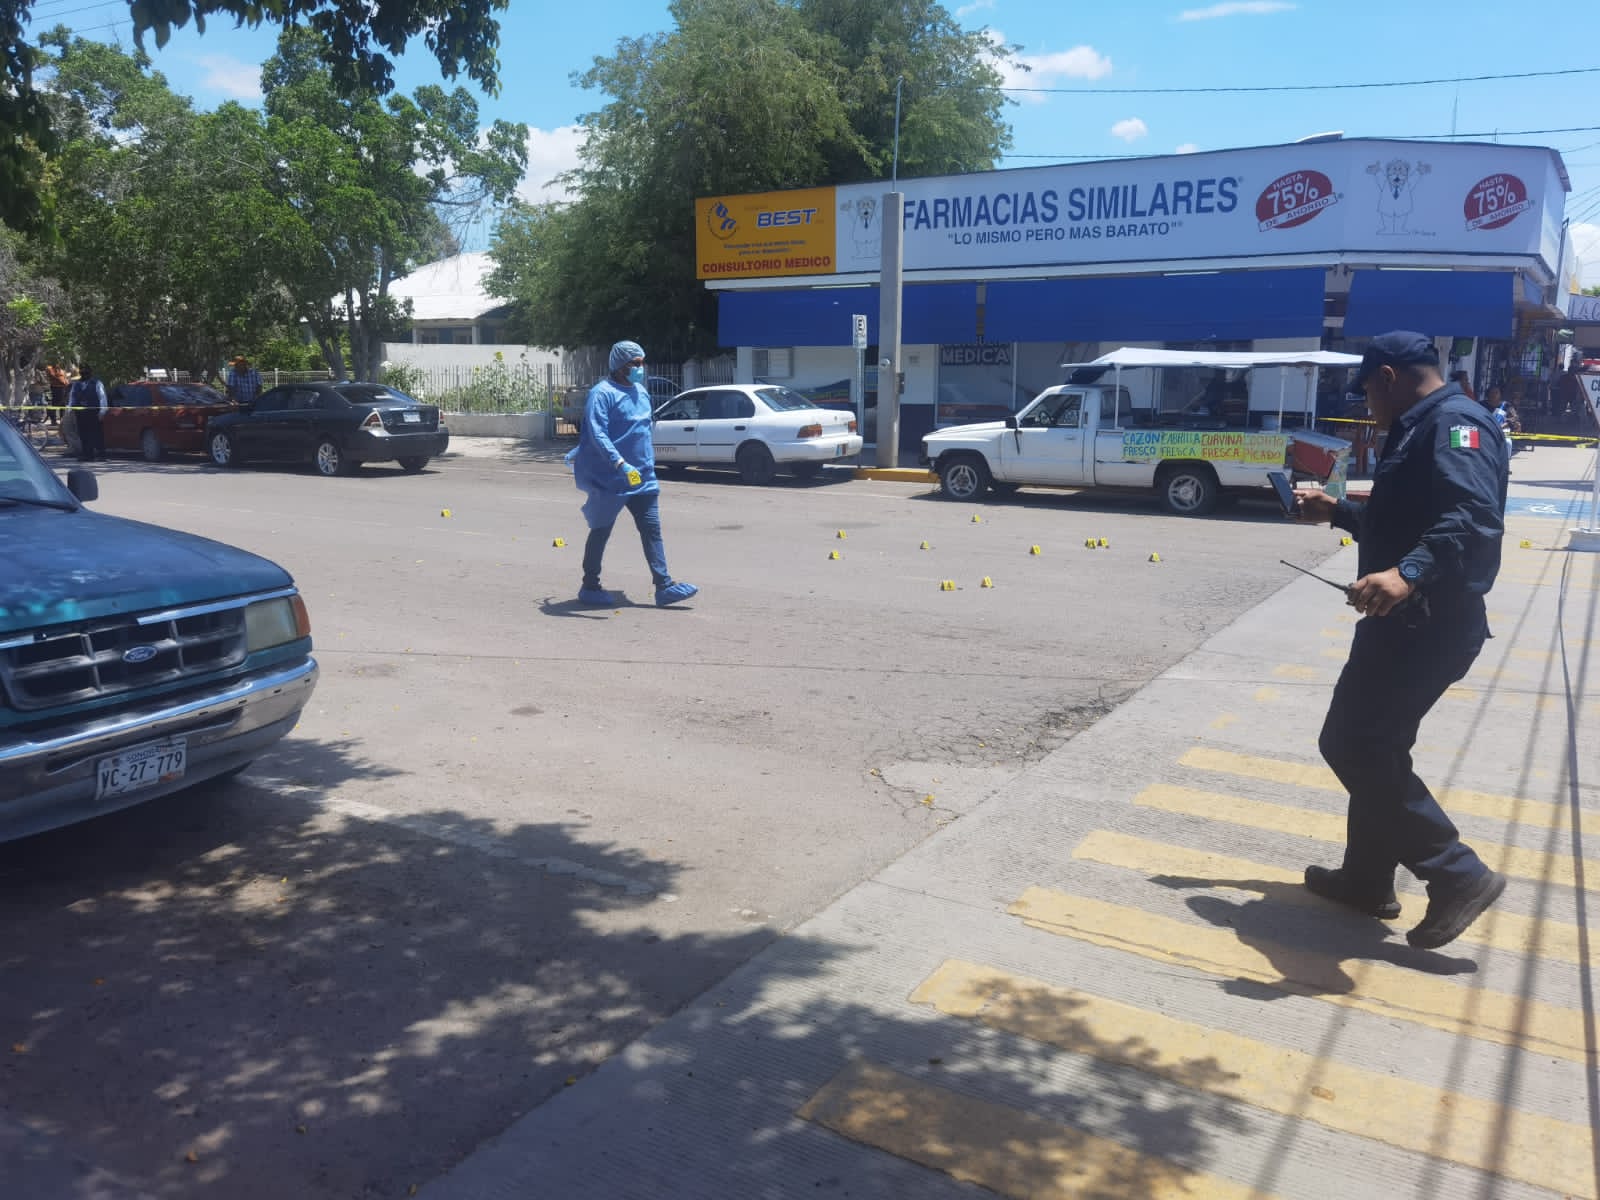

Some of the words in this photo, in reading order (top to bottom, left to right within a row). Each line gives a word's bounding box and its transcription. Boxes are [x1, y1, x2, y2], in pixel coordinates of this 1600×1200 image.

[1273, 174, 1302, 191] HASTA
[903, 188, 1059, 231] FARMACIAS
[1067, 176, 1239, 221] SIMILARES
[1266, 177, 1319, 215] 75%
[1473, 181, 1516, 215] 75%
[757, 208, 817, 228] BEST
[1286, 198, 1329, 219] AHORRO
[975, 230, 1022, 245] MISMO
[1026, 227, 1065, 242] PERO
[1069, 226, 1102, 240] MAS
[702, 259, 782, 273] CONSULTORIO
[785, 256, 831, 269] MEDICO
[1122, 432, 1160, 445] CAZON
[1123, 446, 1157, 457] FRESCO
